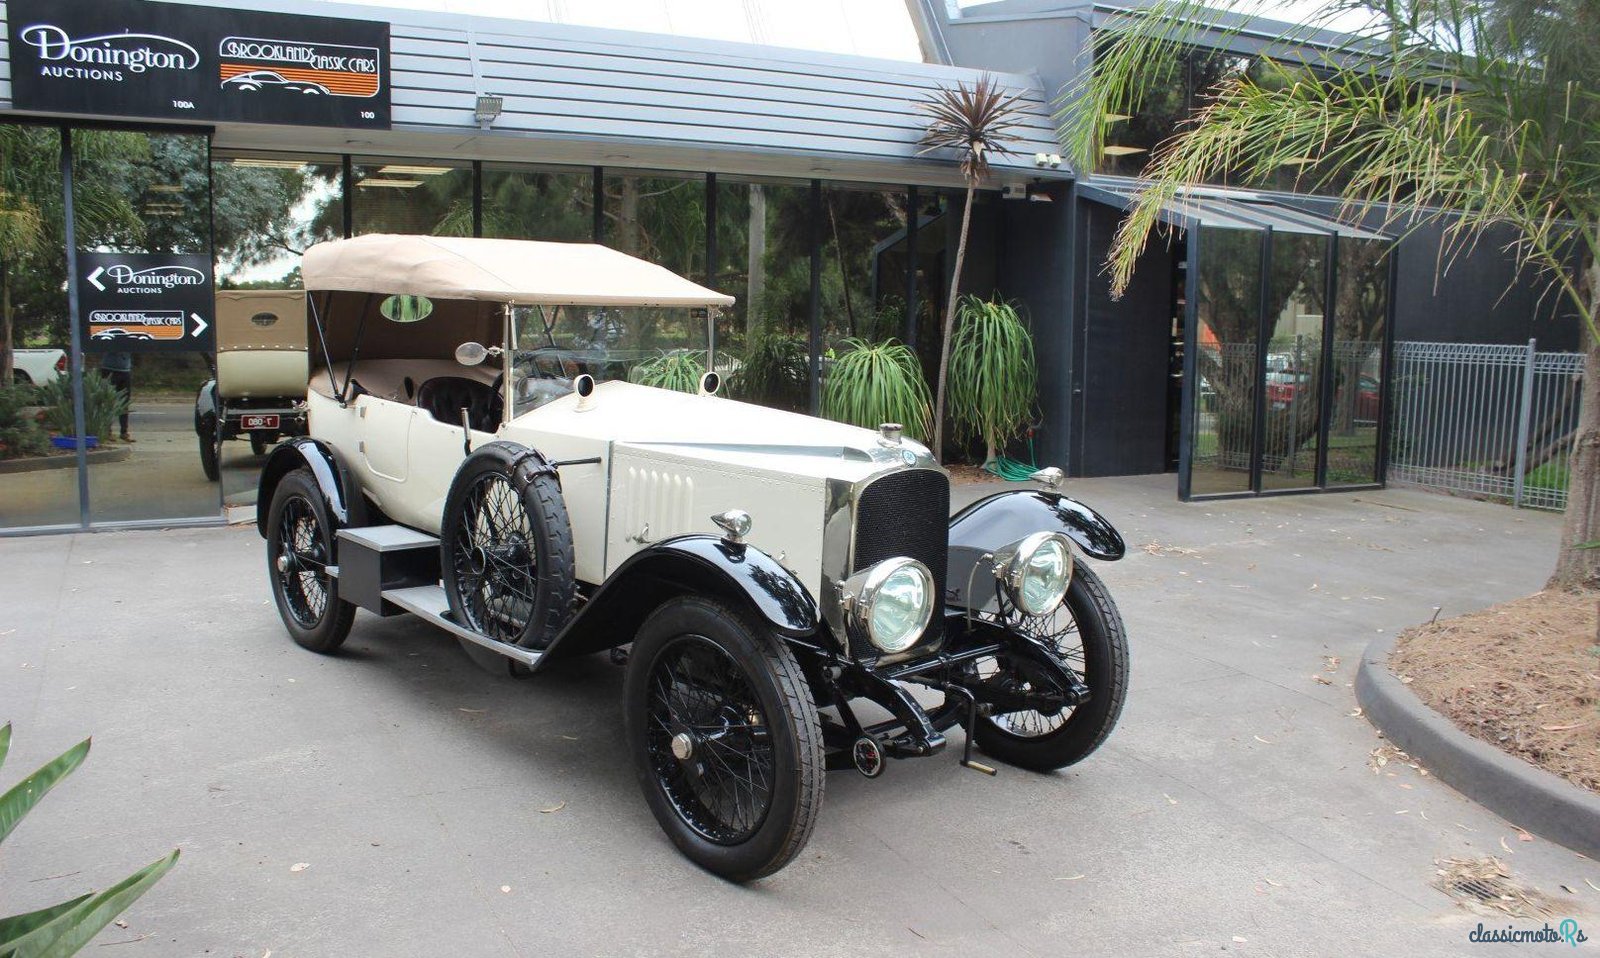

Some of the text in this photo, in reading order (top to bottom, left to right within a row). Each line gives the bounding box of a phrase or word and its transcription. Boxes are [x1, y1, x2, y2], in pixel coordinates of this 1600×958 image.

[21, 25, 199, 73] Donington
[227, 42, 376, 72] BROOKLANDS CLASSIC CARS
[41, 65, 124, 82] AUCTIONS
[172, 100, 195, 109] 100A
[360, 111, 375, 119] 100
[106, 264, 205, 288] Donington
